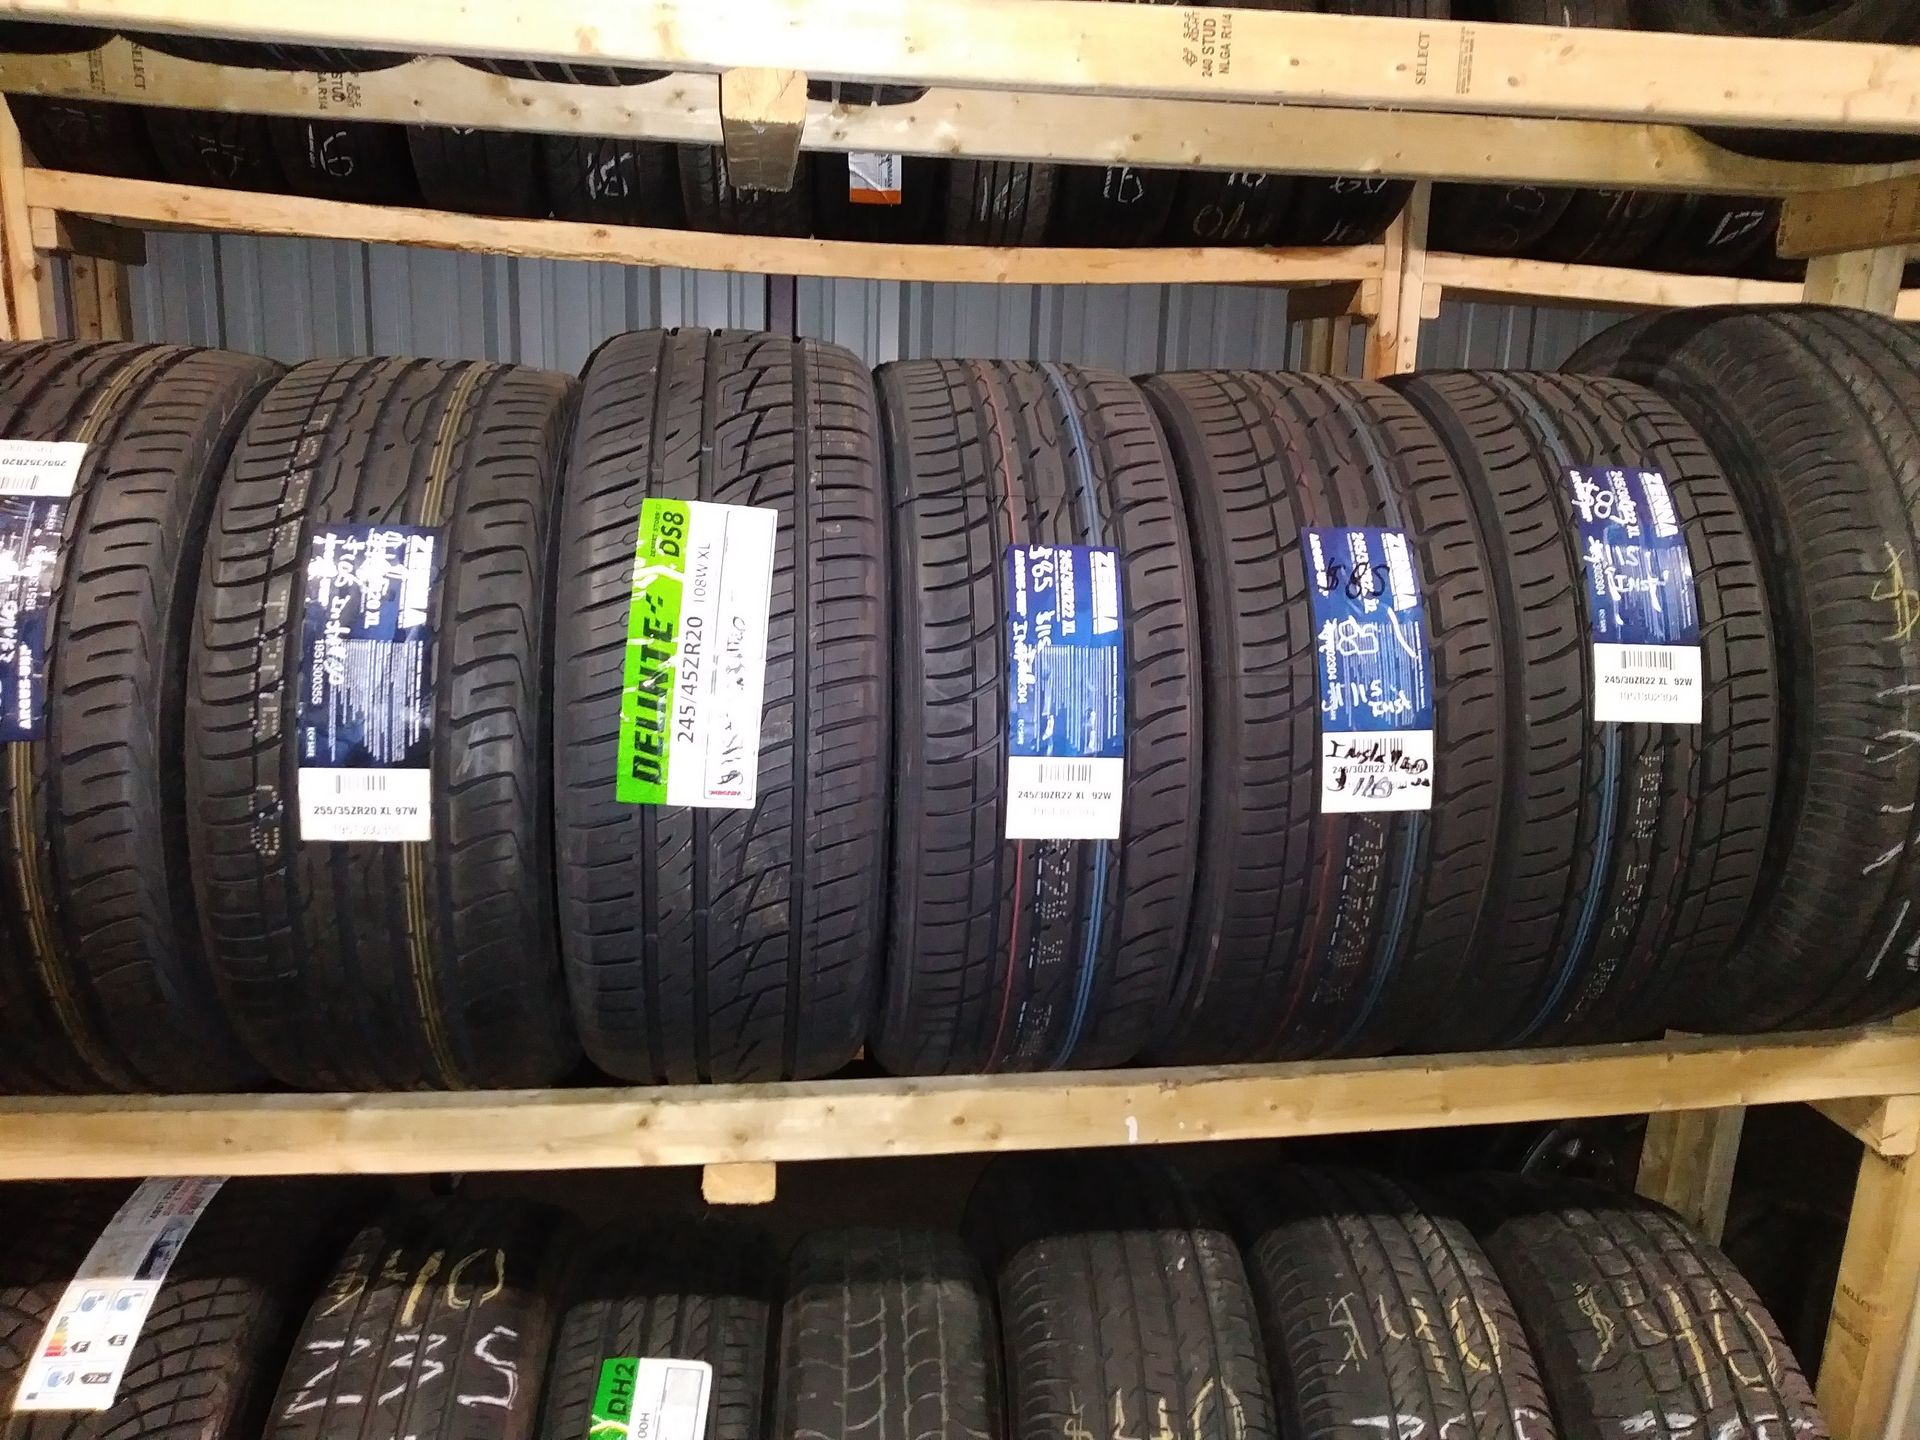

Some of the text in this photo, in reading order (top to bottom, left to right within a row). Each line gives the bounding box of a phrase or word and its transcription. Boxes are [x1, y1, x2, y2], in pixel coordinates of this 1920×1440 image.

[1202, 18, 1216, 55] STUD
[1218, 43, 1231, 75] NLGA
[1415, 31, 1430, 85] SELECT
[131, 42, 146, 90] SELECT
[1643, 472, 1679, 538] ZENNA
[662, 510, 685, 559] DS8
[677, 543, 711, 744] 245/45ZR20 108W XL
[310, 638, 326, 705] 1951300355
[1604, 674, 1693, 687] 245/30ZR22 XL 92W
[631, 618, 674, 787] DELINTE
[313, 804, 418, 816] 255/35ZR20 XL 97W
[1017, 790, 1112, 800] 245/30ZR22 XL 92W
[283, 1323, 521, 1420] 235
[607, 1363, 638, 1418] DH2
